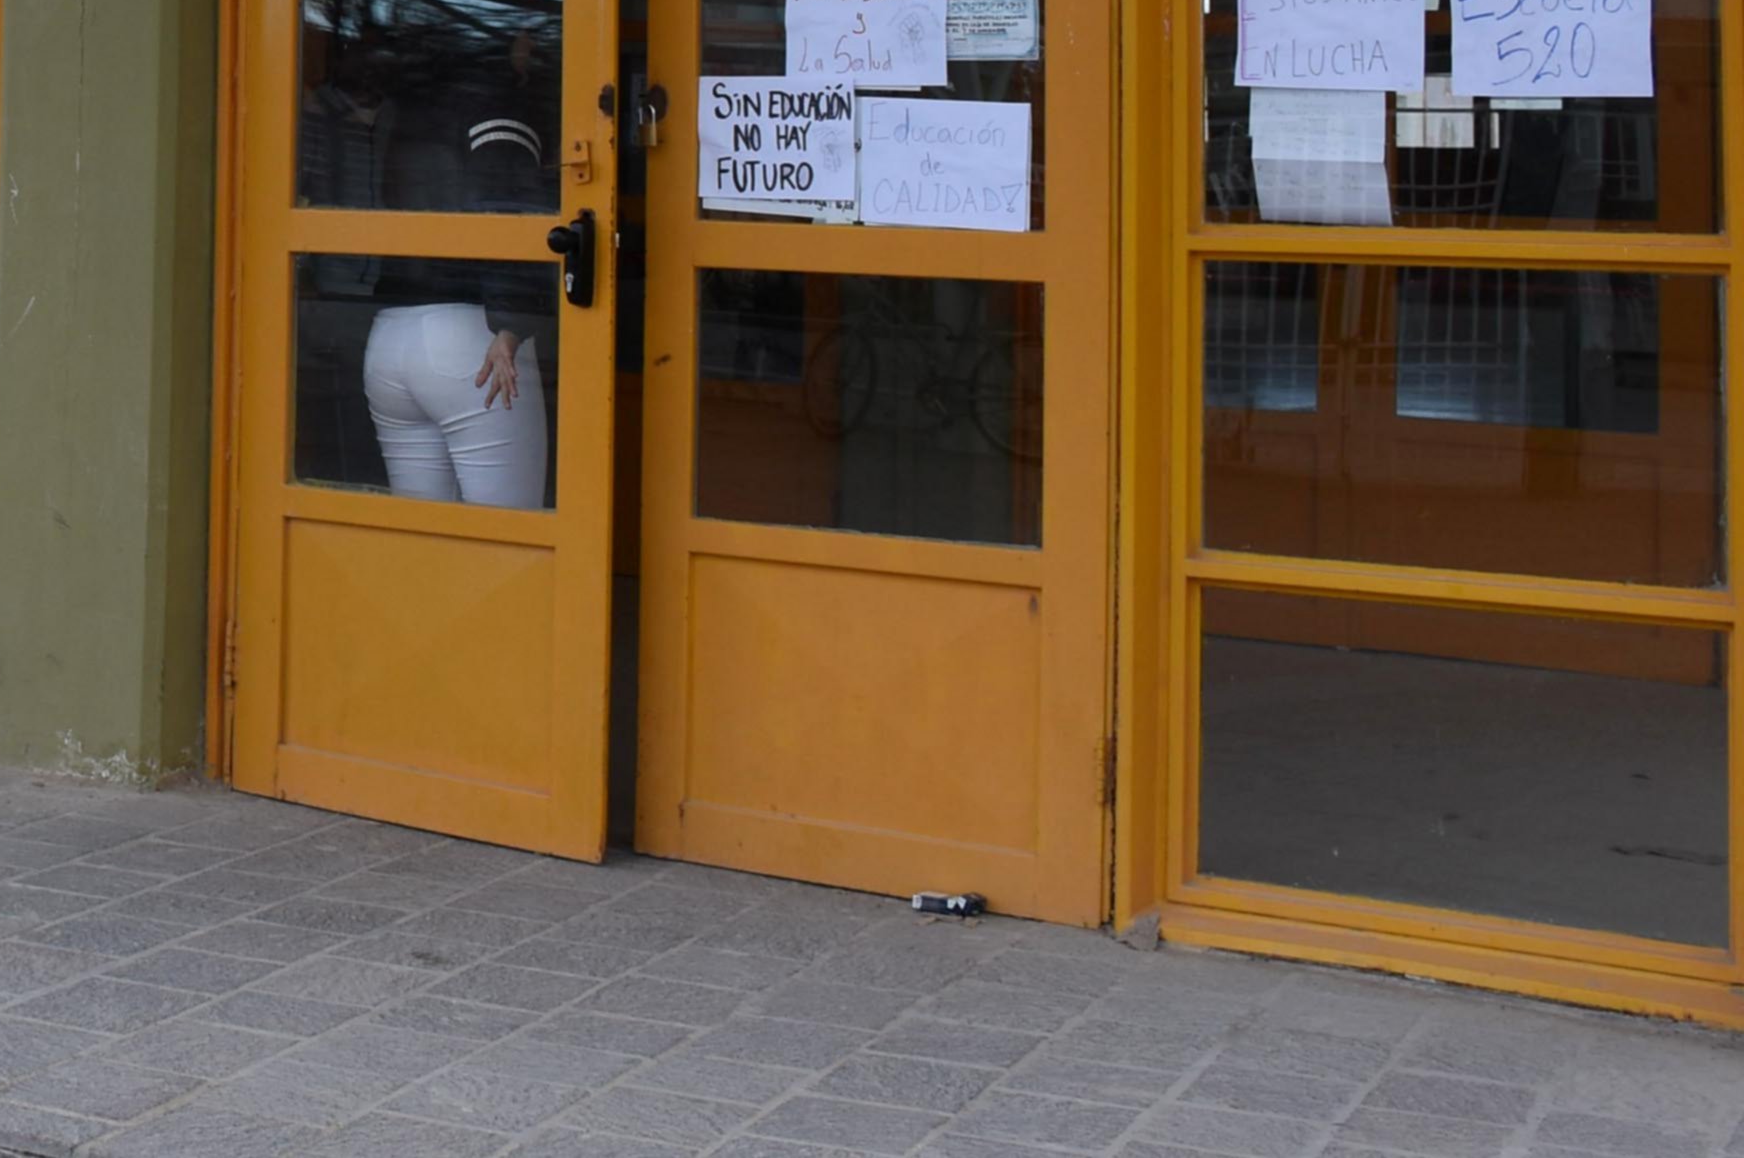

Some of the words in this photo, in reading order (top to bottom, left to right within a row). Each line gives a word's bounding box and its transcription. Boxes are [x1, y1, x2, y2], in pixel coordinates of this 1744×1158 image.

[833, 35, 893, 75] Salud
[1291, 39, 1390, 79] LUCHA
[1491, 22, 1597, 86] 520
[733, 123, 762, 152] NO
[775, 121, 812, 152] HAY
[868, 101, 1007, 149] Educación
[717, 156, 814, 193] FUTURO
[920, 151, 945, 178] de
